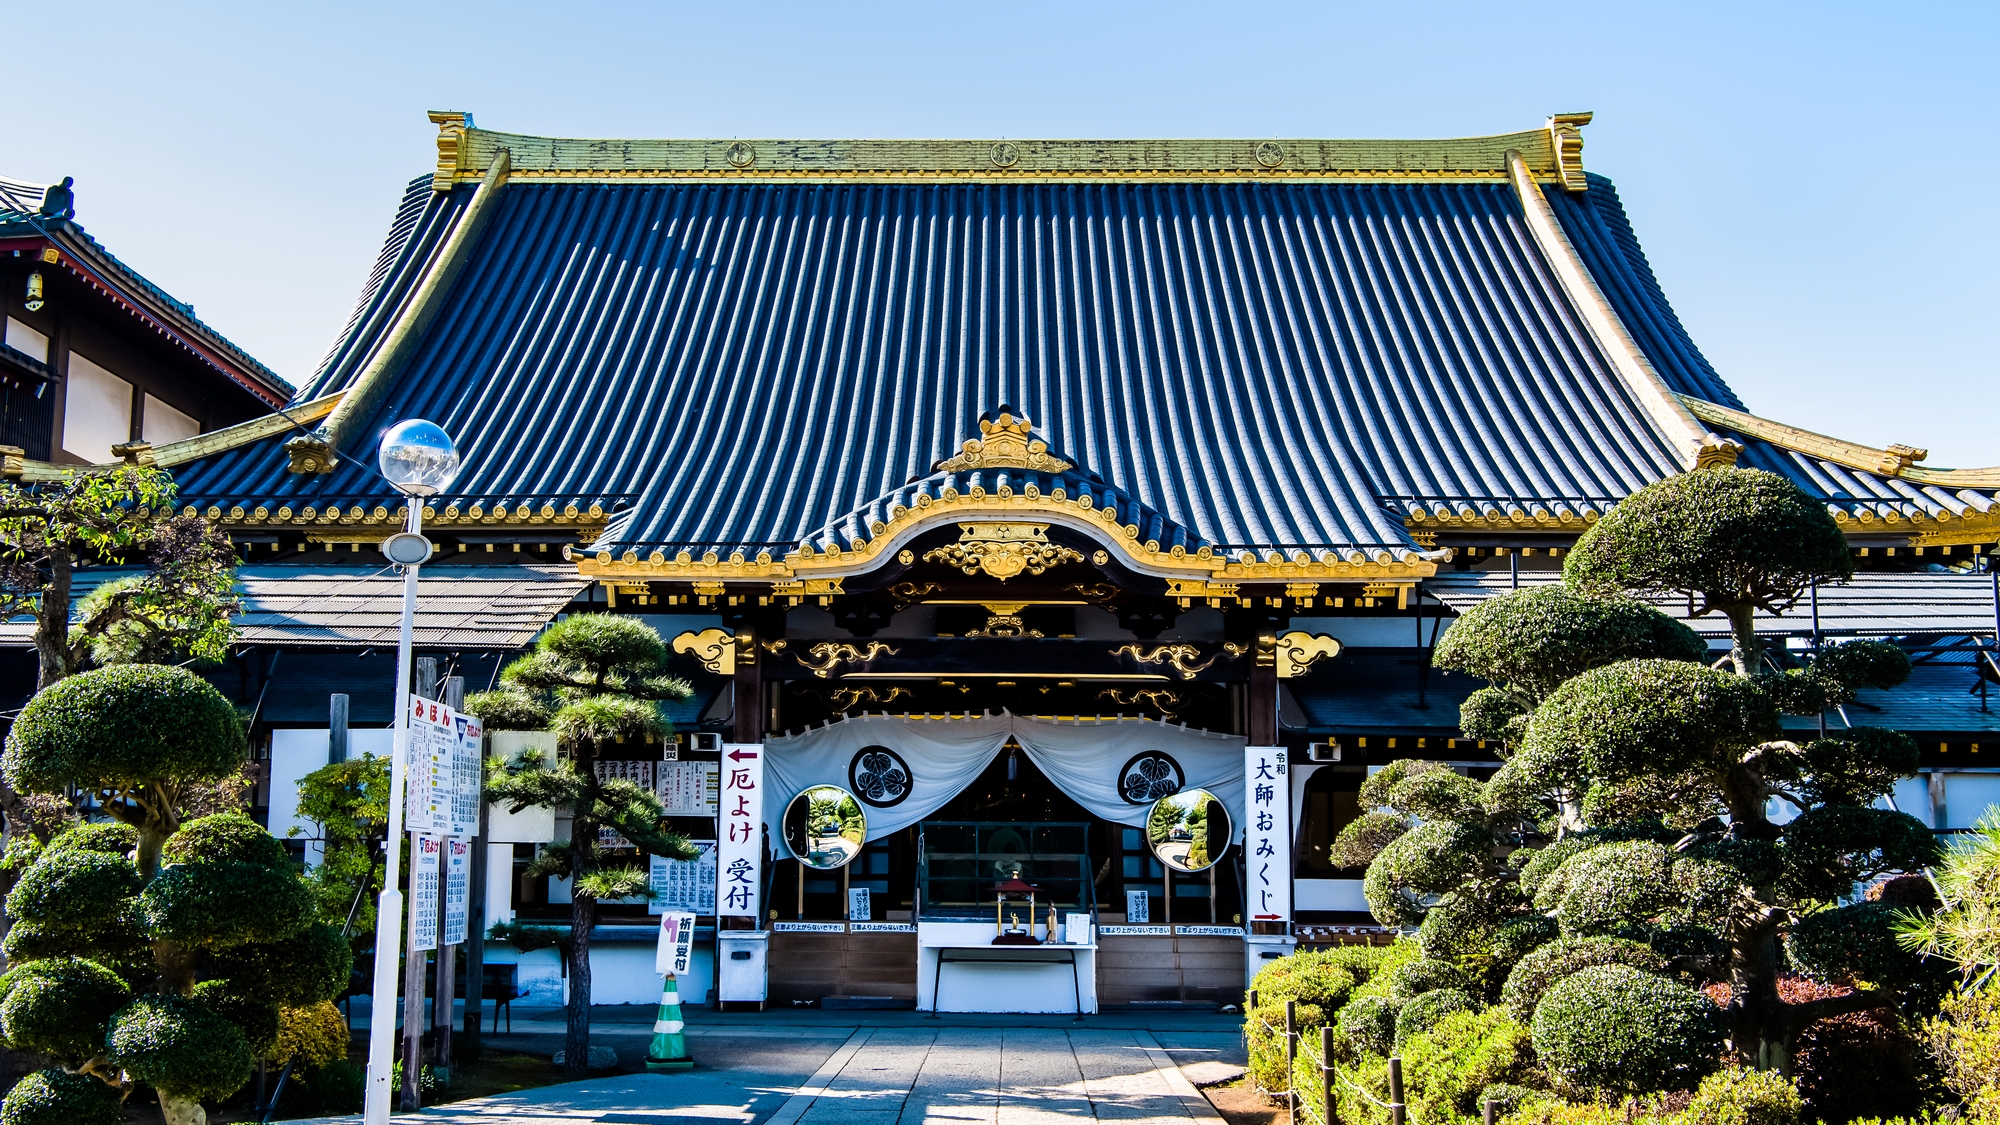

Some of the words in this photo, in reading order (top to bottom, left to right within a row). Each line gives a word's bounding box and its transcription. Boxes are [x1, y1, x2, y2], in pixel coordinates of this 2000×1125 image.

[415, 699, 450, 727] みほん
[1275, 752, 1286, 775] 令和
[726, 768, 756, 845] 厄よけ
[1254, 757, 1276, 913] 大師おみくじ
[723, 857, 755, 911] 受付
[674, 917, 693, 972] 祈願受付
